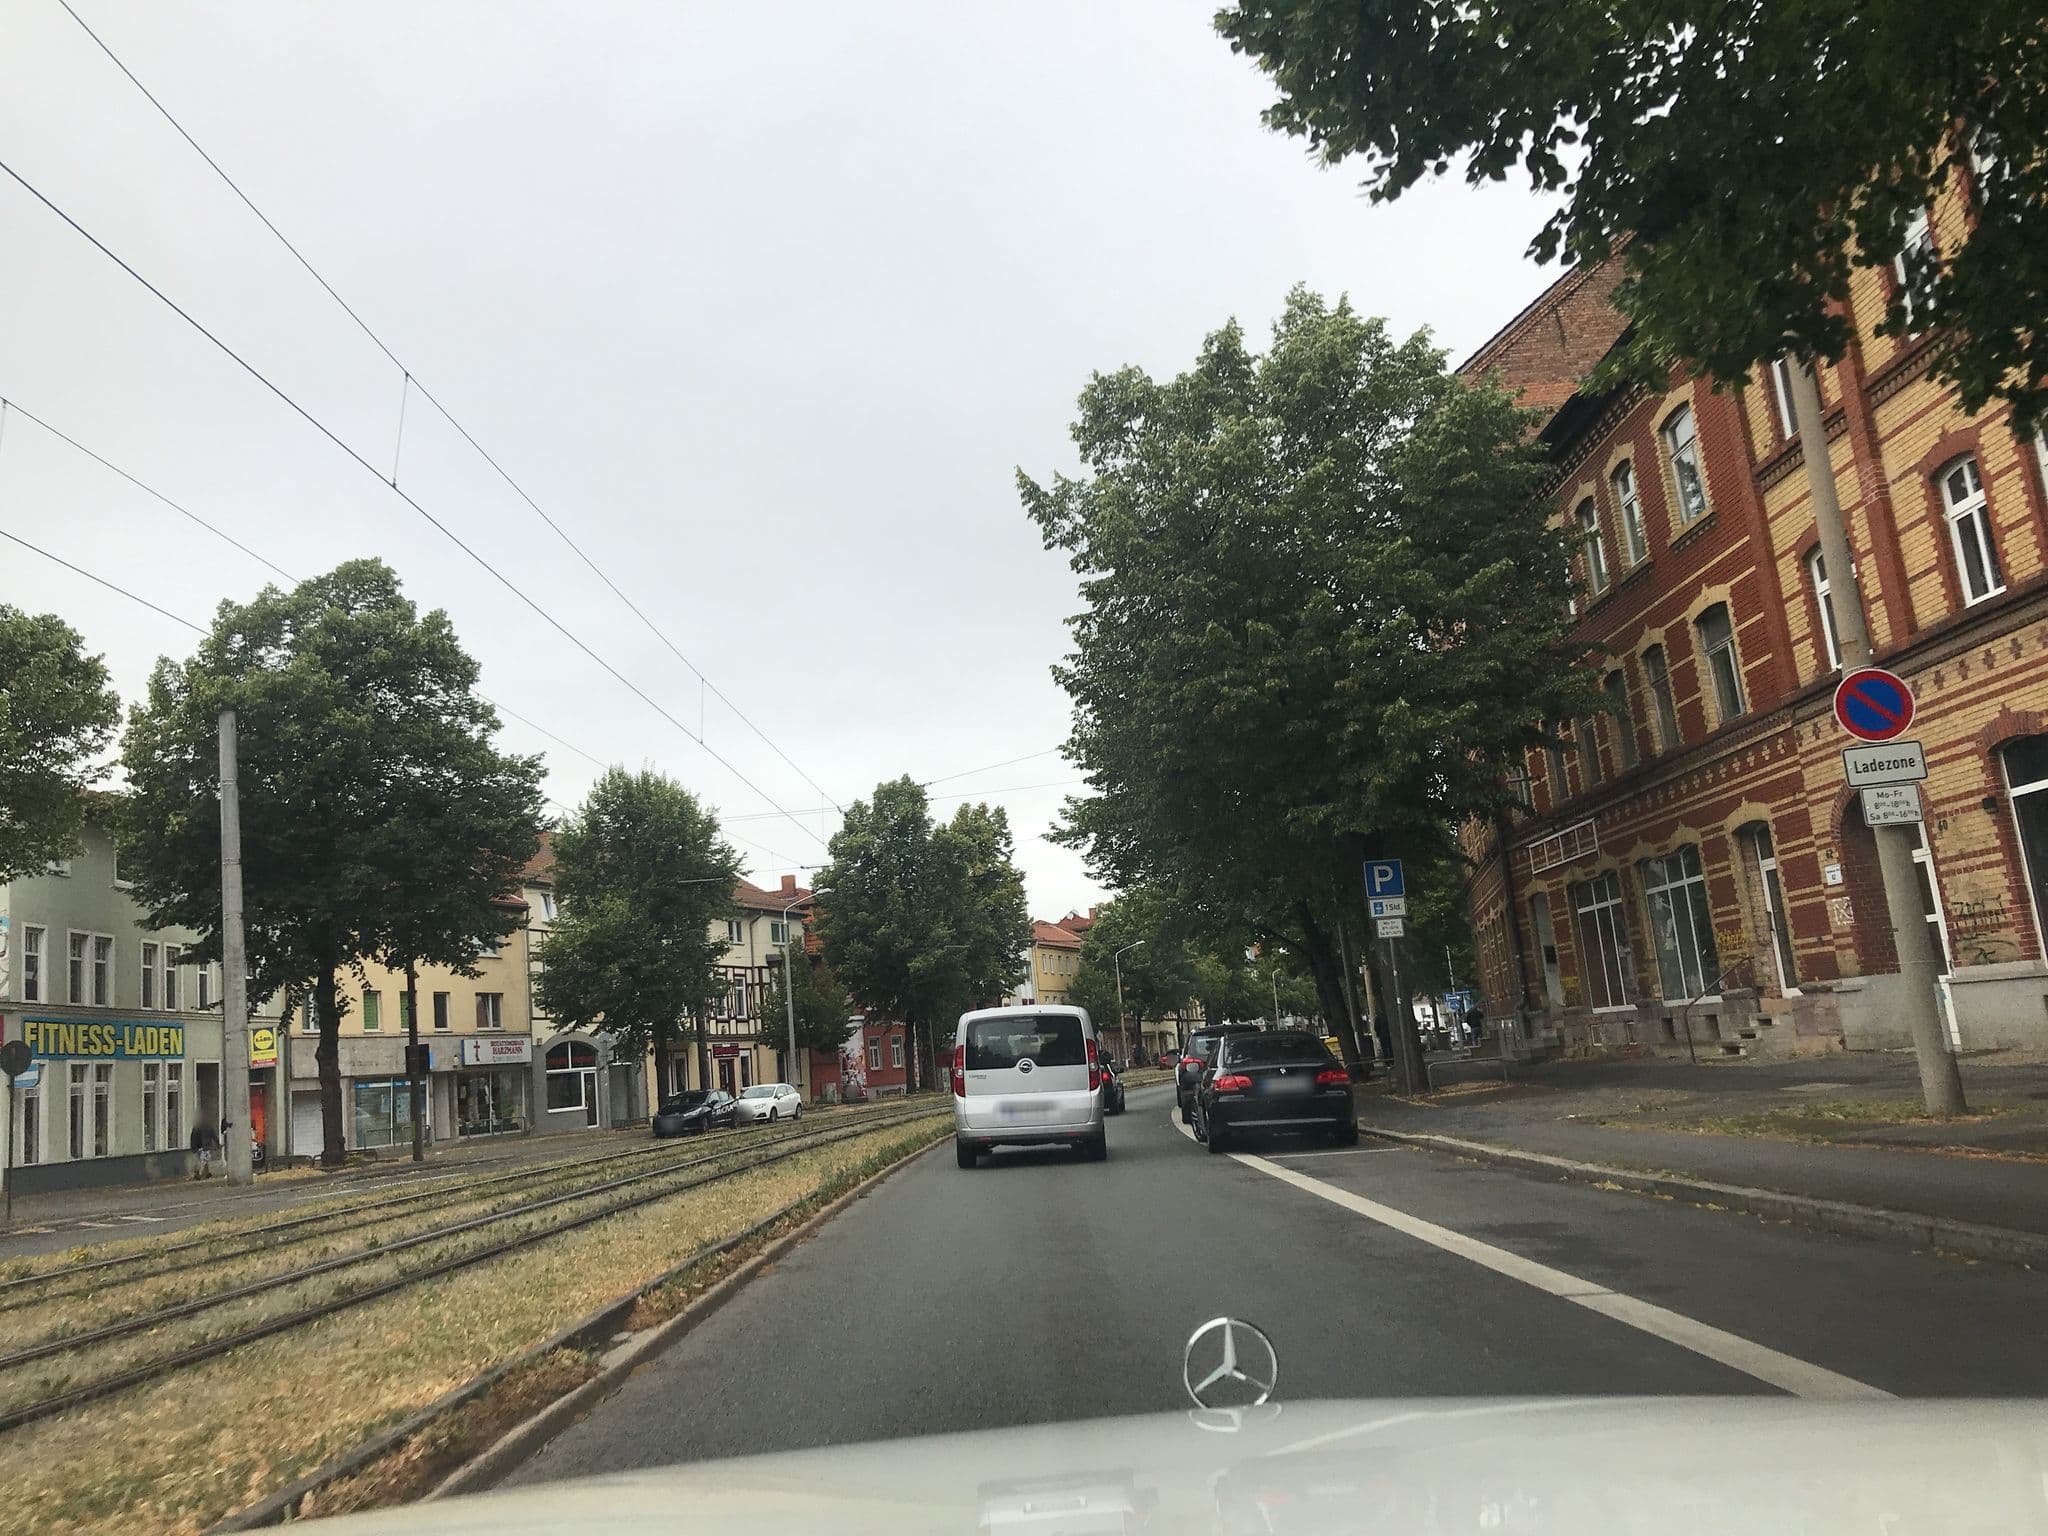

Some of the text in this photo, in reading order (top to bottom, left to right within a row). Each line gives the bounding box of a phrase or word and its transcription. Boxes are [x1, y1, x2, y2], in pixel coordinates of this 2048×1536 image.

[1854, 757, 1916, 774] Ladezone
[1876, 790, 1903, 799] Mo-Fr
[1373, 865, 1393, 892] P
[24, 1021, 183, 1056] FITNESS-LADEN
